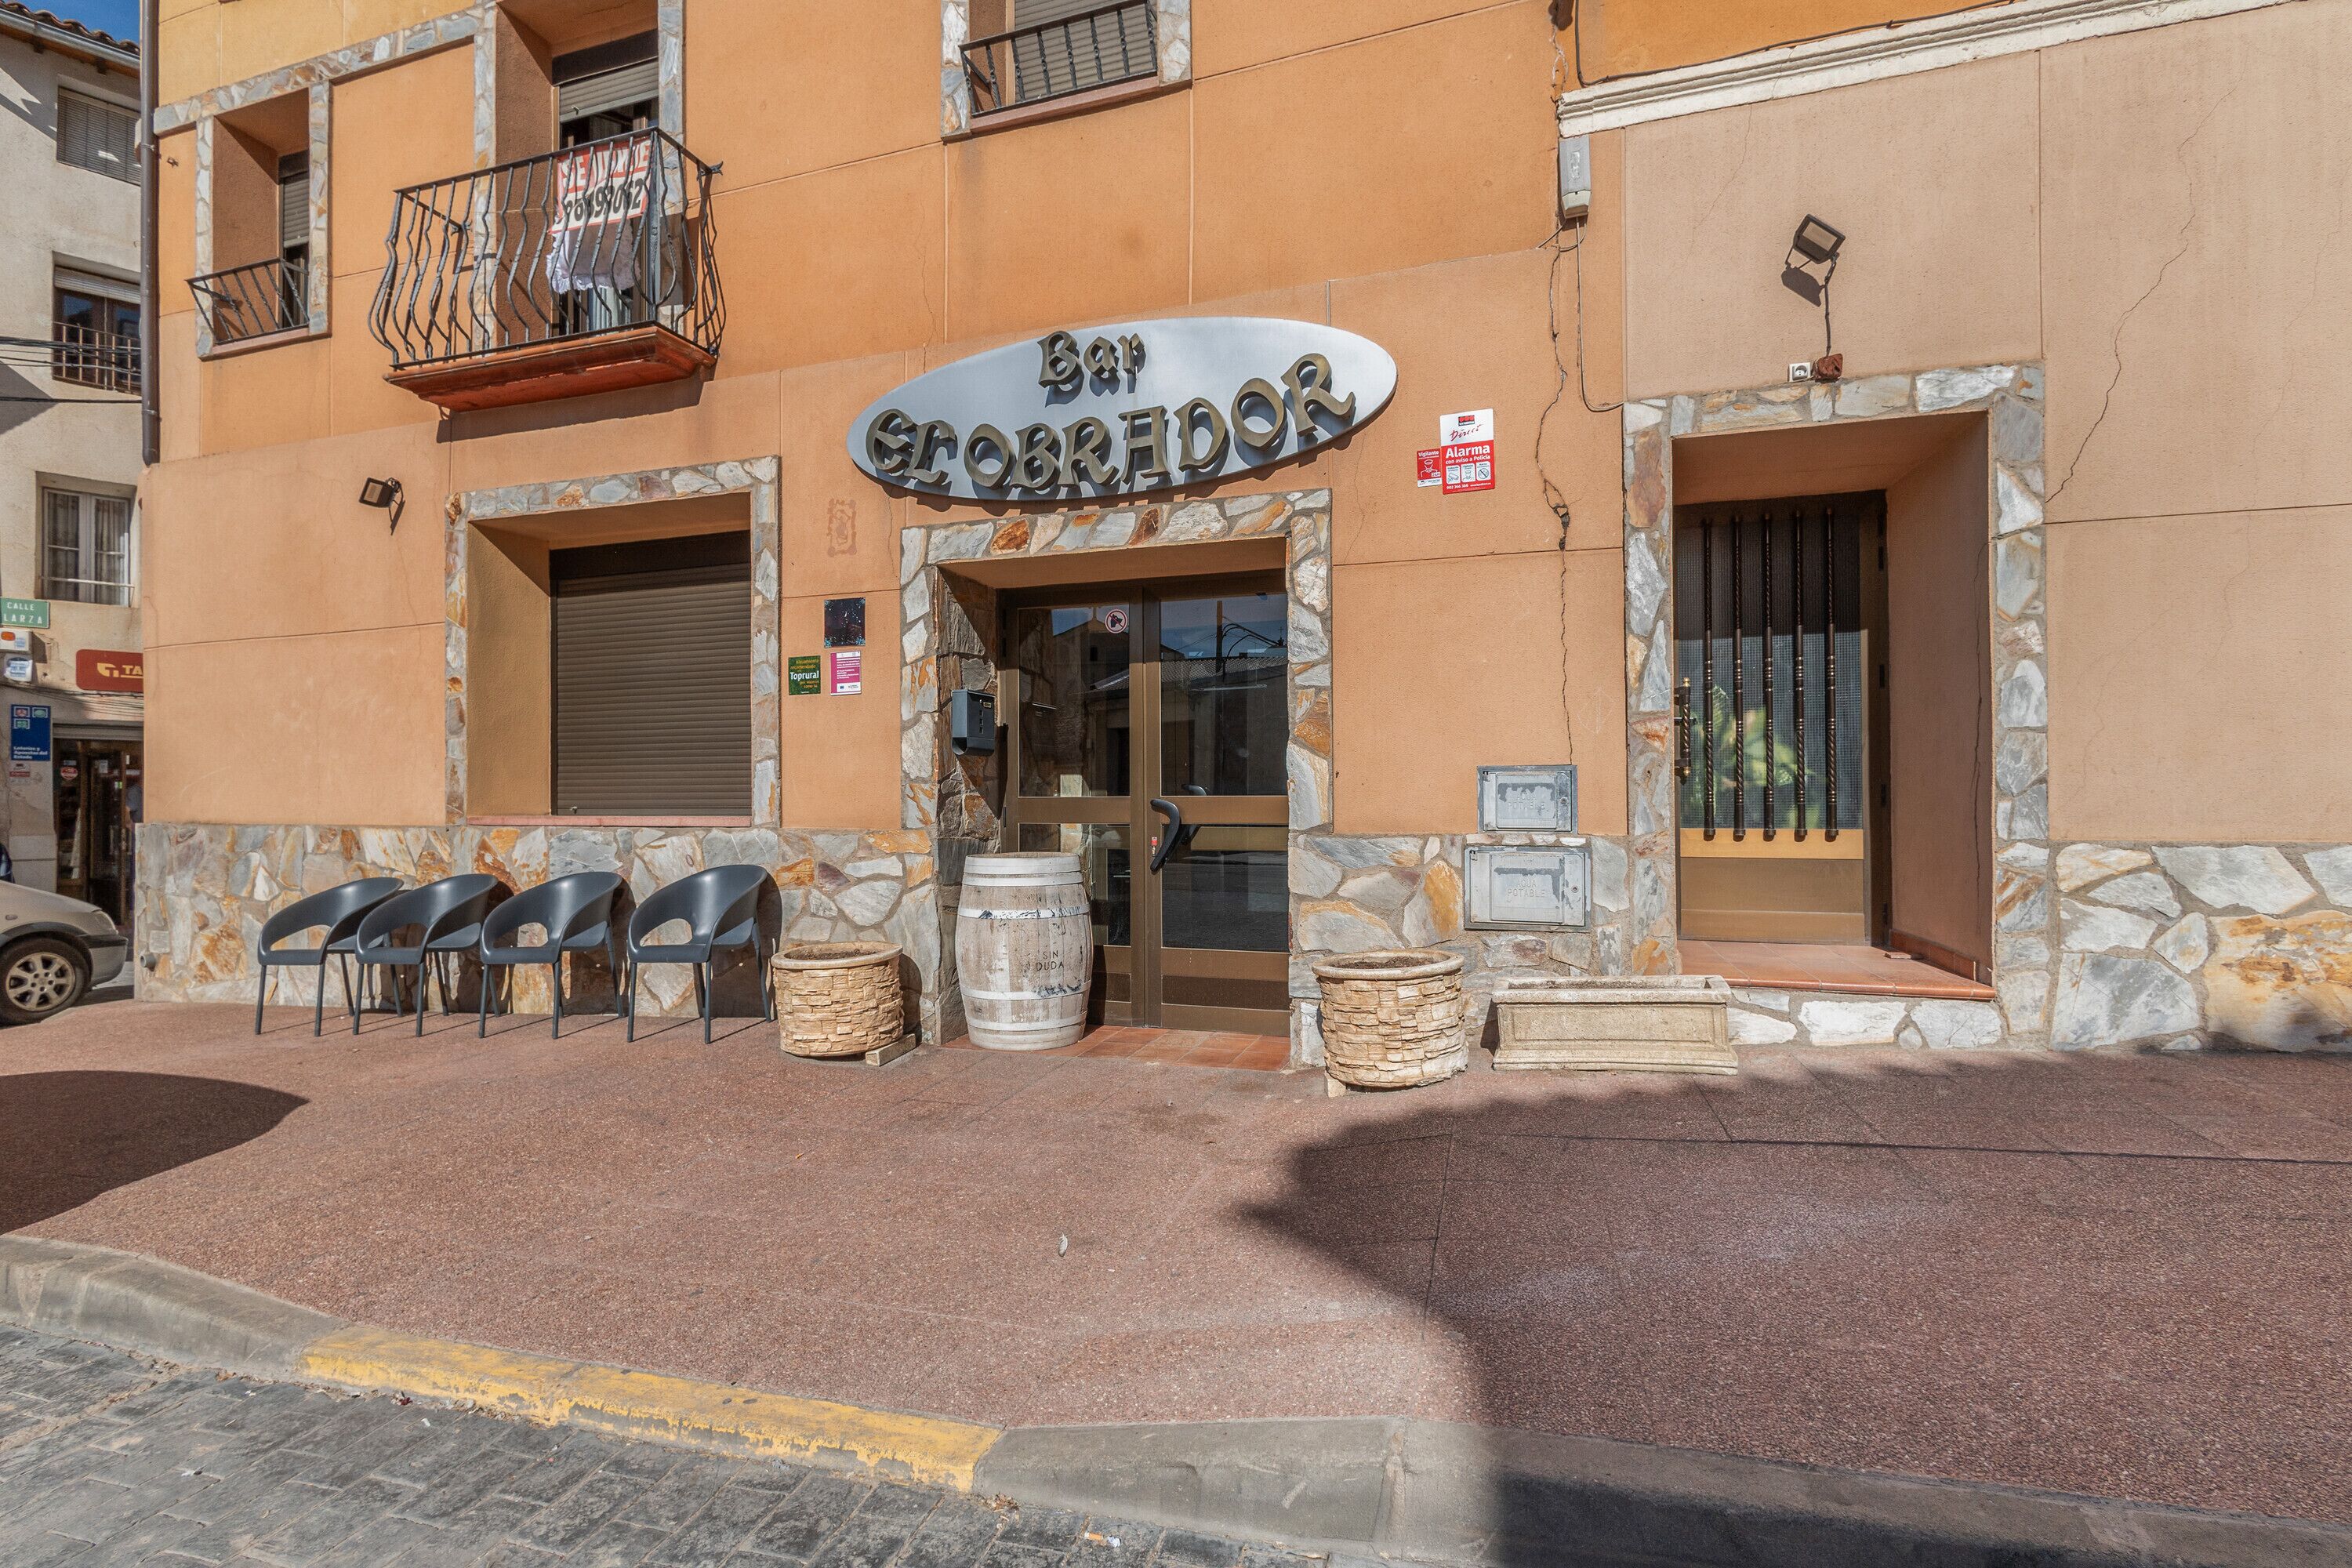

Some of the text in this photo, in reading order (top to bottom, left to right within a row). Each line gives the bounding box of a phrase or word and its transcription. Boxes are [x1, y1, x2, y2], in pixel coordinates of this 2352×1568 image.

[561, 155, 586, 189] SE
[1037, 330, 1145, 389] Bar
[1445, 445, 1491, 459] Alarma
[6, 601, 35, 611] CALLE
[3, 613, 43, 625] LARZA
[789, 670, 819, 682] Toprural
[1506, 887, 1547, 898] POTABLE
[1042, 949, 1059, 960] SIN
[1036, 960, 1065, 971] DUDA
